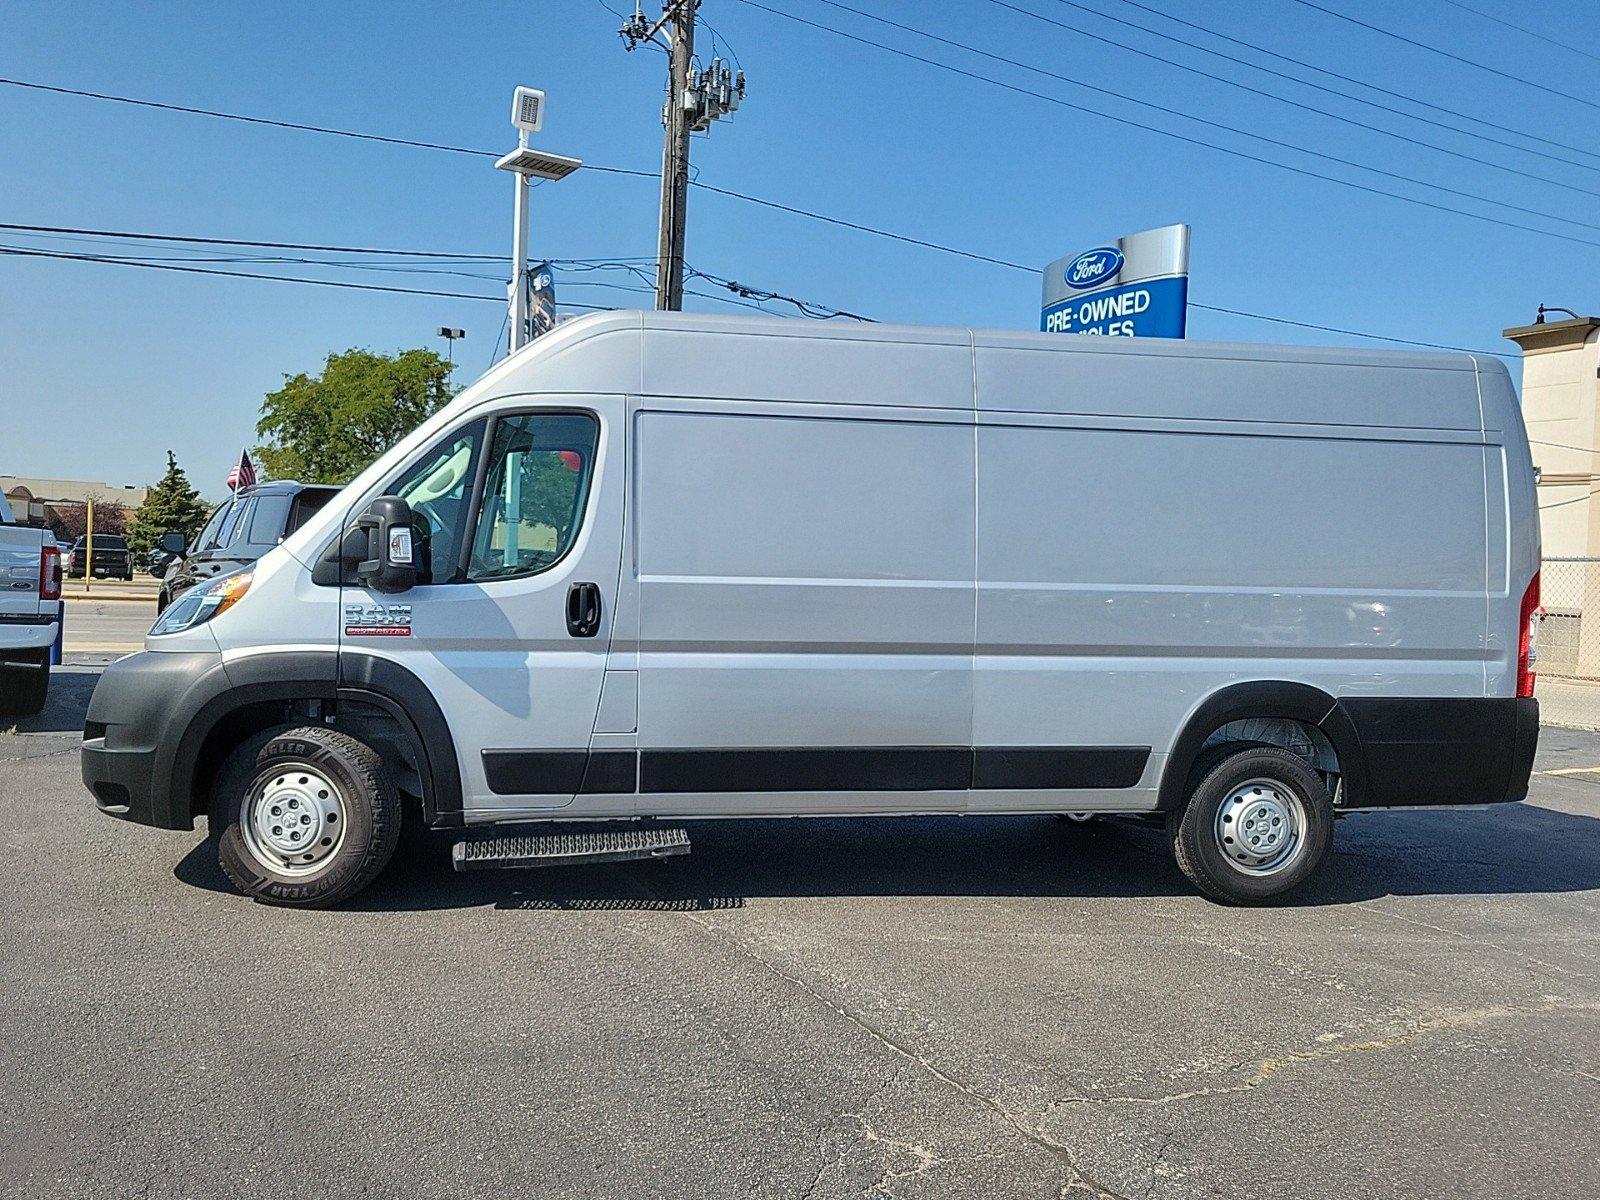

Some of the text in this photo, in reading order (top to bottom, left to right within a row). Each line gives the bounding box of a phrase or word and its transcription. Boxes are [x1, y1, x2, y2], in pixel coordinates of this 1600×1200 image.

[1073, 254, 1106, 281] Ford
[1046, 290, 1150, 333] PRE-OWNED
[345, 604, 412, 615] RAM
